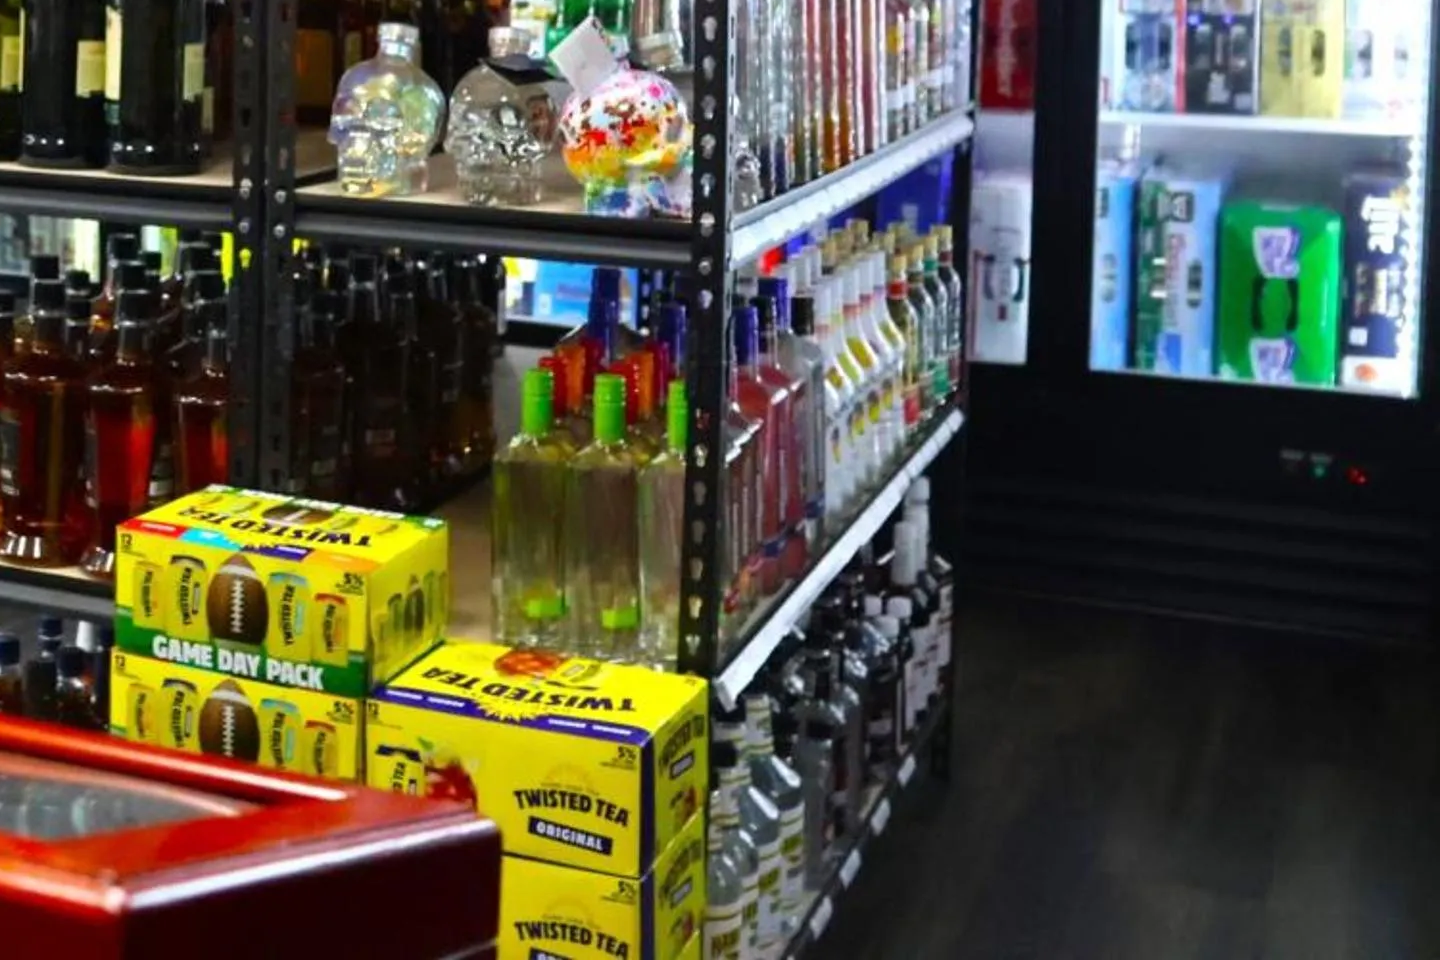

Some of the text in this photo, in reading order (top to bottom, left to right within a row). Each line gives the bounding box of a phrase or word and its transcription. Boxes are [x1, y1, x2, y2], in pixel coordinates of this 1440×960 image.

[152, 636, 325, 691] GAME DAY PACK
[421, 666, 479, 691] TEA
[481, 682, 637, 713] TWISTED
[513, 789, 592, 813] TWISTED
[595, 798, 629, 828] TEA
[536, 821, 604, 852] ORIGINAL
[513, 920, 629, 959] TWISTED TEA
